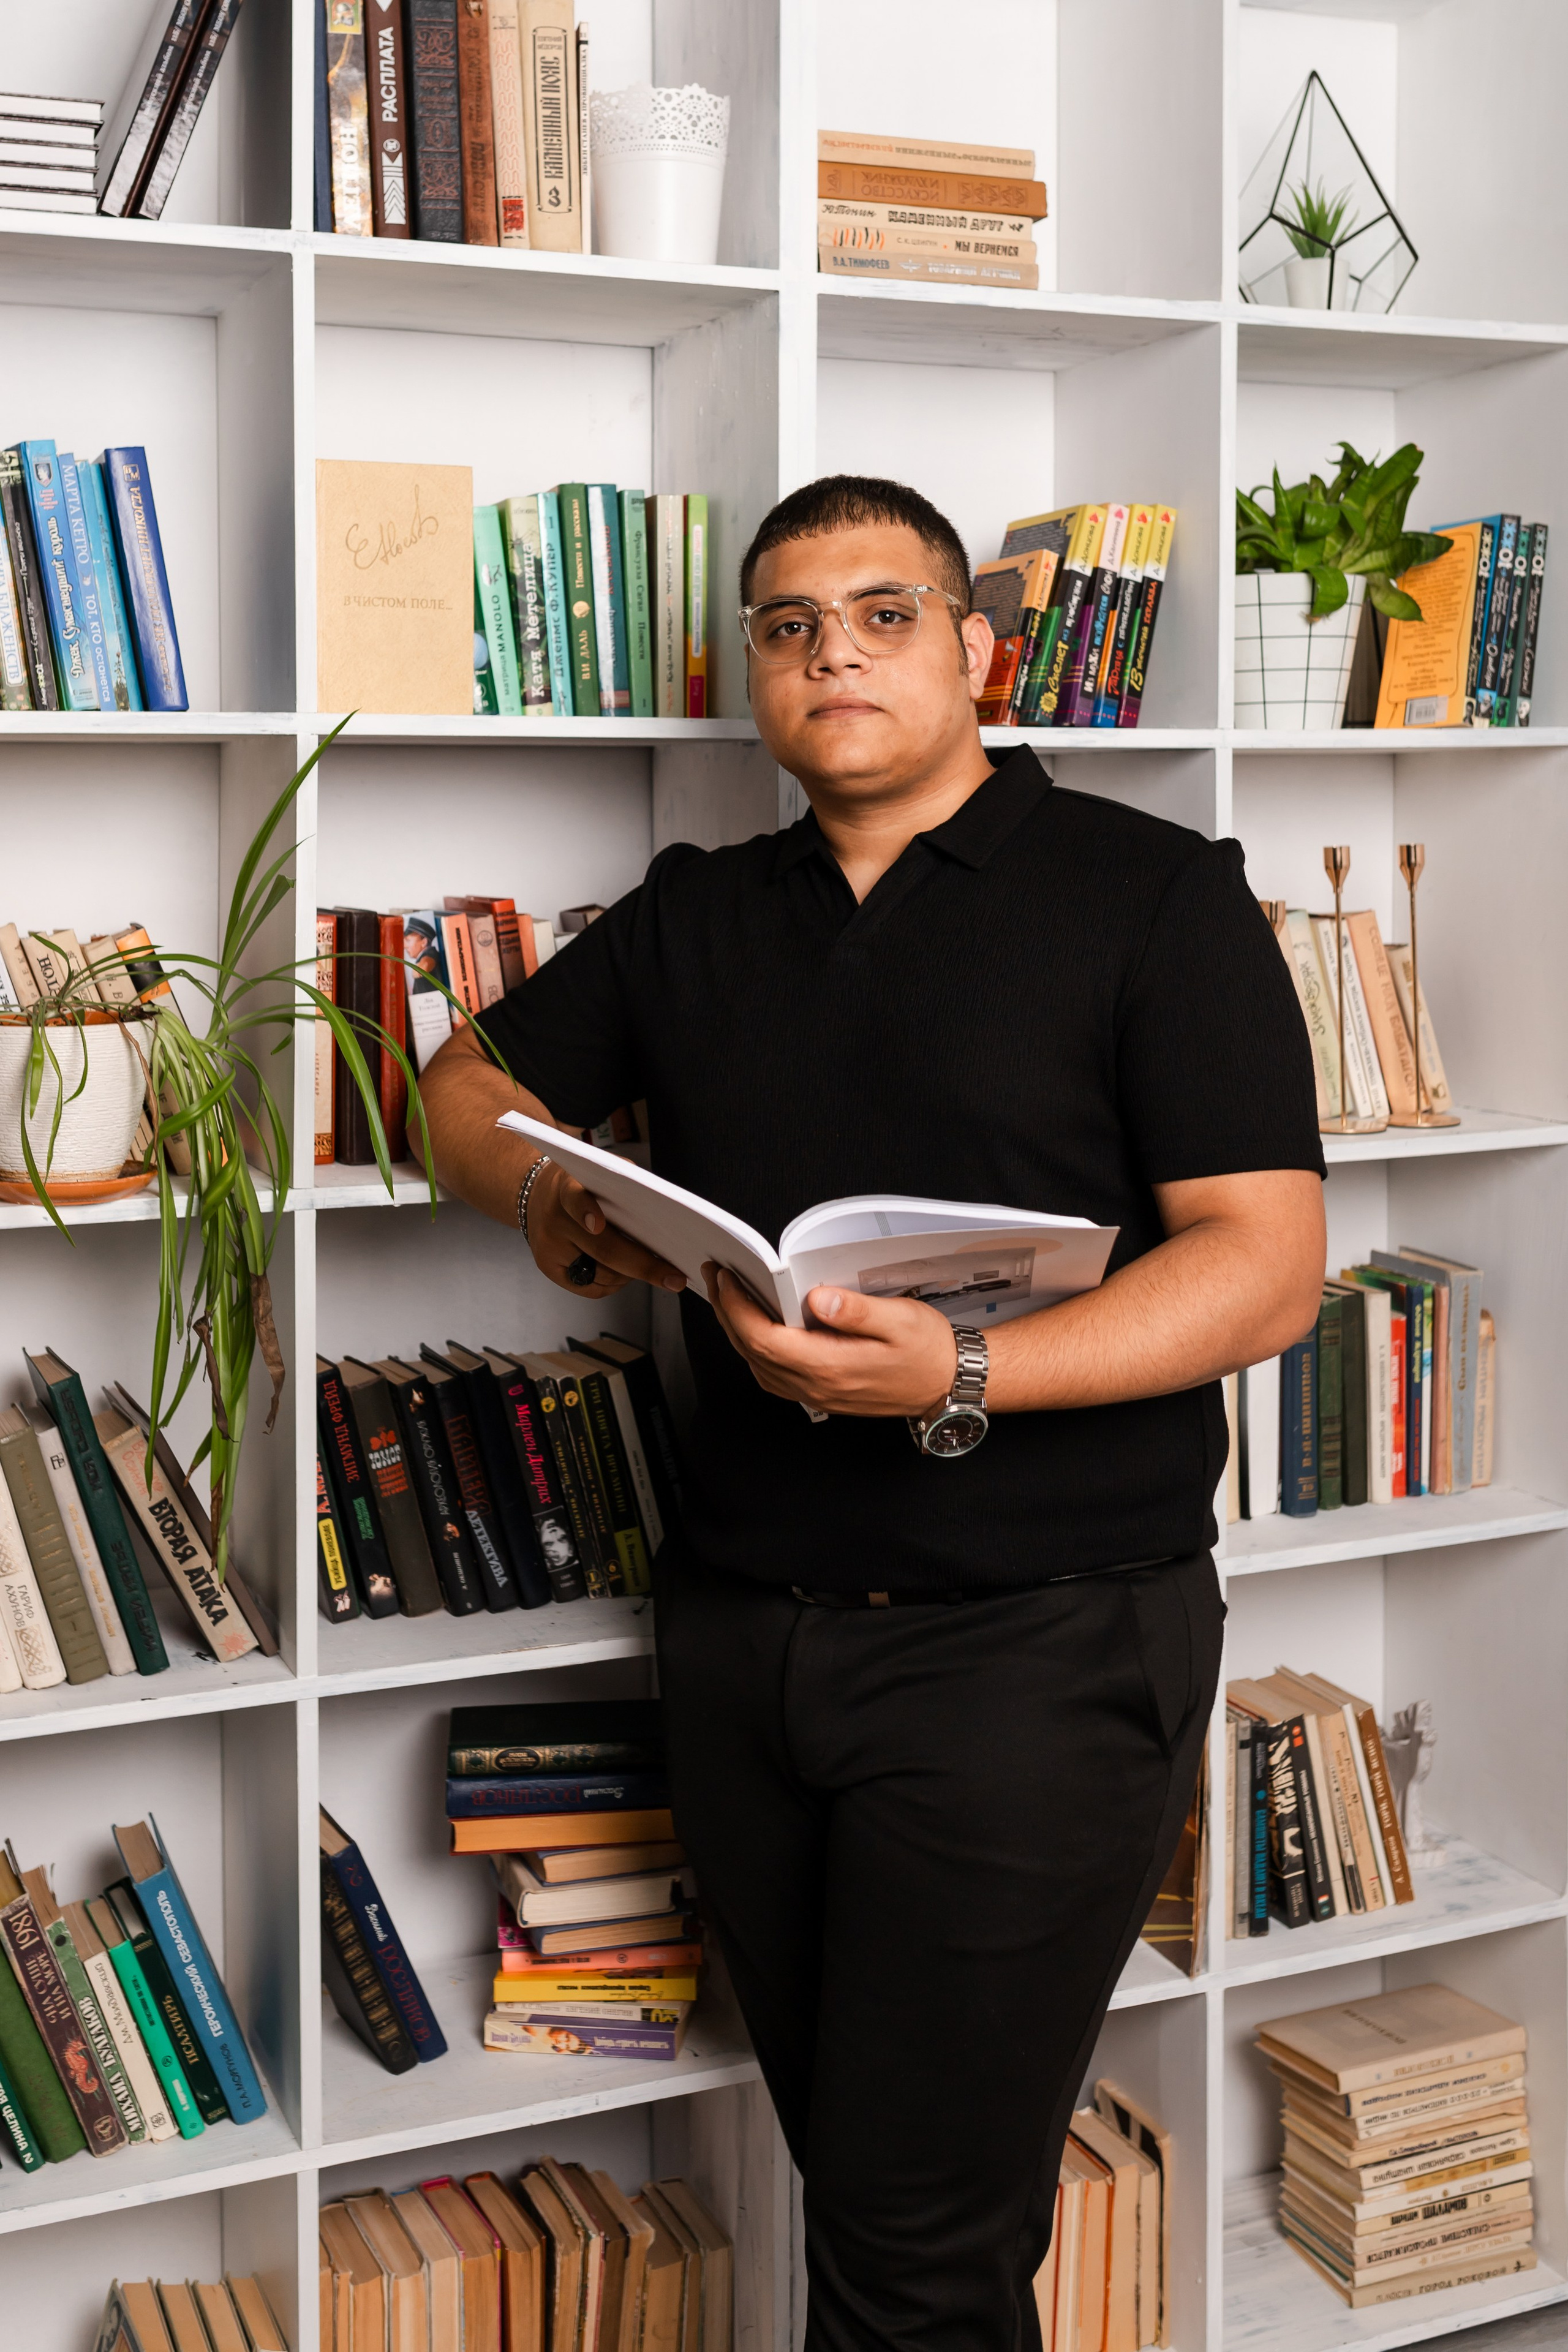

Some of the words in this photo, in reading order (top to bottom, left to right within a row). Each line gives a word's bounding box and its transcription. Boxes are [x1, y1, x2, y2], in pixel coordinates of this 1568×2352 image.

[156, 43, 175, 73] альбом
[194, 48, 213, 77] альбом
[377, 26, 398, 123] РАСПЛАТА
[539, 55, 561, 93] ПОЯС
[540, 96, 564, 179] КАМЕННЫЙ
[337, 126, 363, 231] ЛЕГИОН
[861, 183, 939, 202] ИСКУССТВО
[970, 218, 1003, 233] ДРУГ
[954, 240, 970, 252] МЫ
[973, 242, 1019, 257] ВЕРНЕМСЯ
[61, 462, 81, 514] МАРТА
[46, 516, 65, 556] король
[126, 486, 151, 545] НИКОГДА
[569, 498, 582, 537] рассказы
[70, 517, 90, 565] КЕТРО
[632, 530, 643, 579] Франсуаза
[136, 544, 165, 623] ПОМЕРКНЕТ
[518, 541, 543, 640] Метелица
[572, 551, 585, 587] Повести
[46, 556, 82, 640] Сумасшедший
[344, 595, 350, 605] В
[353, 597, 405, 608] ЧИСТОМ
[636, 584, 644, 612] Саган
[1063, 579, 1085, 627] пробирки
[89, 620, 102, 644] КТО
[153, 622, 166, 643] НЕ
[491, 594, 505, 652] MANOLO
[578, 630, 589, 658] ДАЛЬ
[637, 622, 646, 660] Повести
[1061, 628, 1070, 641] из
[65, 639, 85, 679] Джек
[551, 616, 564, 677] Джеймс
[1044, 639, 1072, 693] Скелет
[94, 646, 111, 702] останется
[499, 655, 511, 695] матрица
[527, 649, 545, 698] Катя
[1082, 676, 1095, 692] Из
[1128, 666, 1144, 691] 13
[320, 1379, 346, 1424] ФРЕЙД
[589, 1381, 601, 1404] ТРИ
[508, 1400, 543, 1453] Марлен
[332, 1423, 361, 1483] ЗИГМУНД
[521, 1449, 557, 1507] Дитрих
[145, 1496, 202, 1566] ВТОРАЯ
[179, 1559, 235, 1627] АТАКА
[466, 1507, 509, 1589] ДЕТЕКТИВА
[0, 1582, 29, 1628] АХУНОВ
[13, 1583, 39, 1619] ГАРИФ
[583, 1787, 624, 1800] Василий
[1, 1905, 47, 1952] 1981
[153, 1888, 194, 1964] СЕВАСТОПОЛЬ
[363, 1901, 391, 1943] Василий
[20, 1956, 51, 1996] СУШЕ
[31, 1948, 60, 1986] МОРЕ
[48, 1985, 68, 2007] НА
[58, 2006, 72, 2019] И
[183, 1962, 225, 2038] ГЕРОИЧЕСКИЙ
[75, 1994, 118, 2069] БУЛГАКОВ
[160, 1993, 200, 2065] ПСАЛТИРЬ
[106, 2070, 144, 2133] МИХАИЛ
[0, 2103, 29, 2153] ЦЕЛИНА
[22, 2151, 35, 2164] 2
